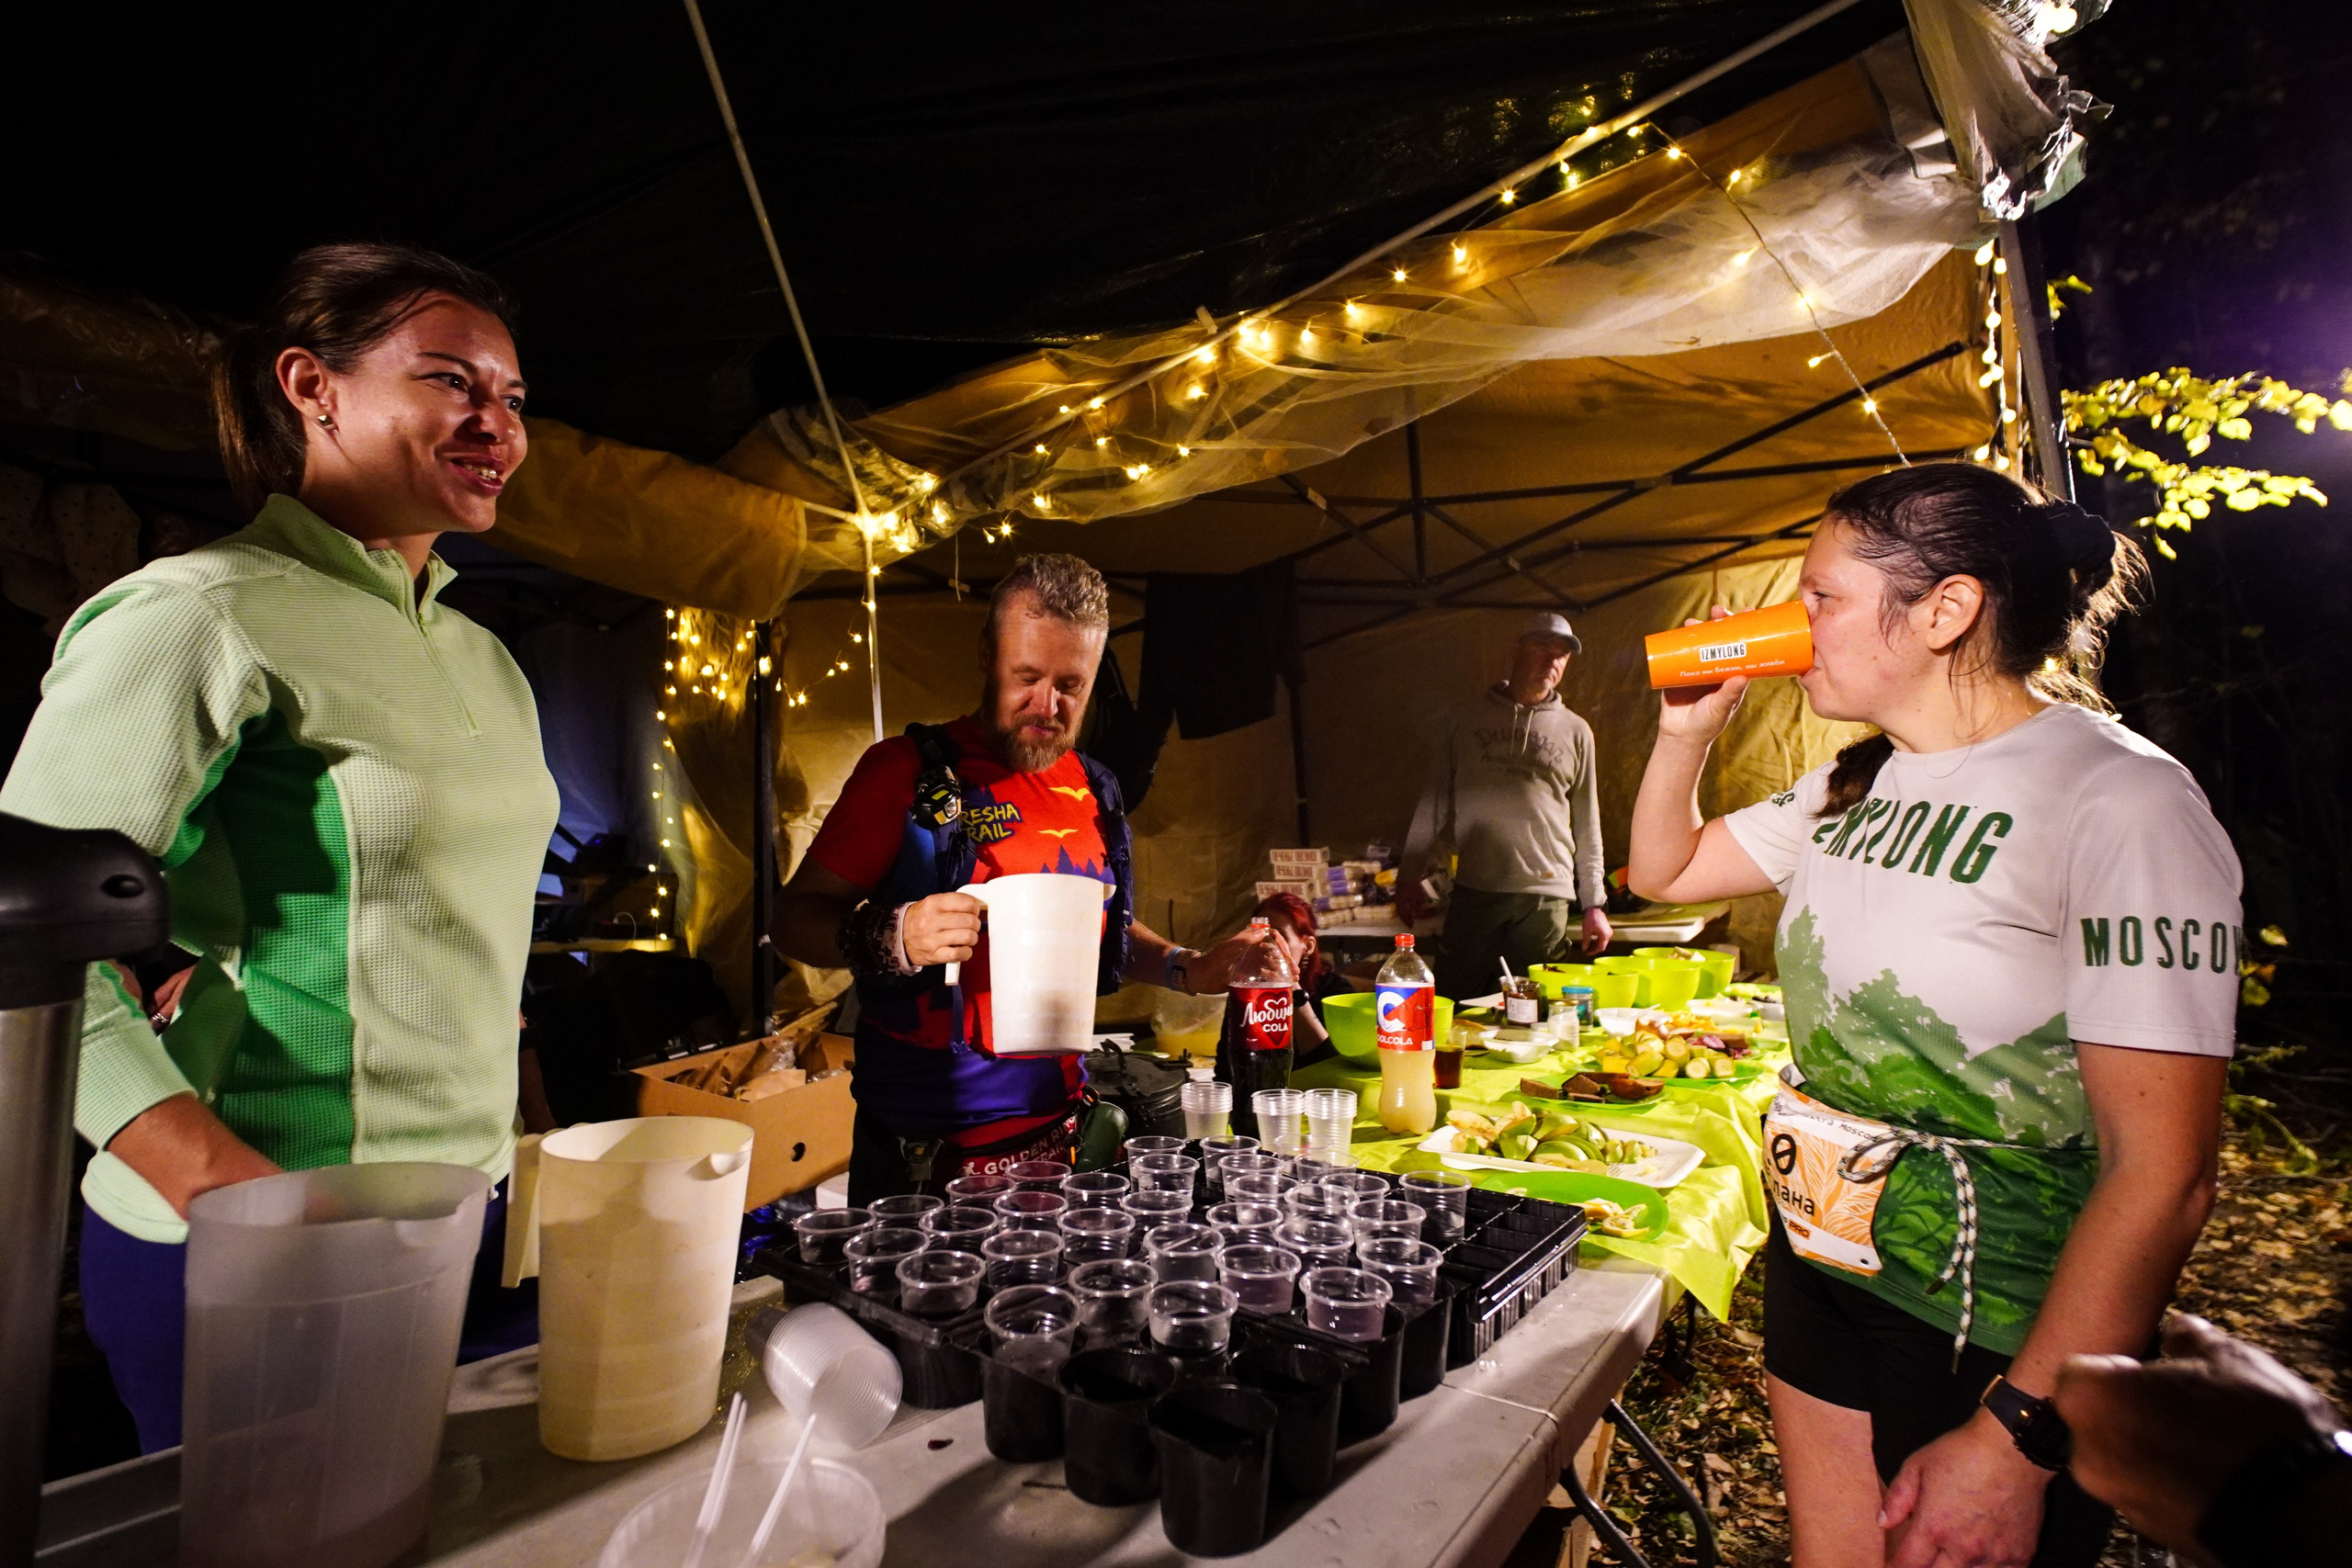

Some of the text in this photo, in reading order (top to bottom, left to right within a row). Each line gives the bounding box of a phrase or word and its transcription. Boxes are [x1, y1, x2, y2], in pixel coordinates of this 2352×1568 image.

[1701, 644, 1745, 660] IZMYLONG
[961, 803, 1020, 827] RESHA
[962, 822, 1012, 843] RAIL
[1262, 1022, 1288, 1032] COLA
[1789, 1220, 1811, 1237] PRO
